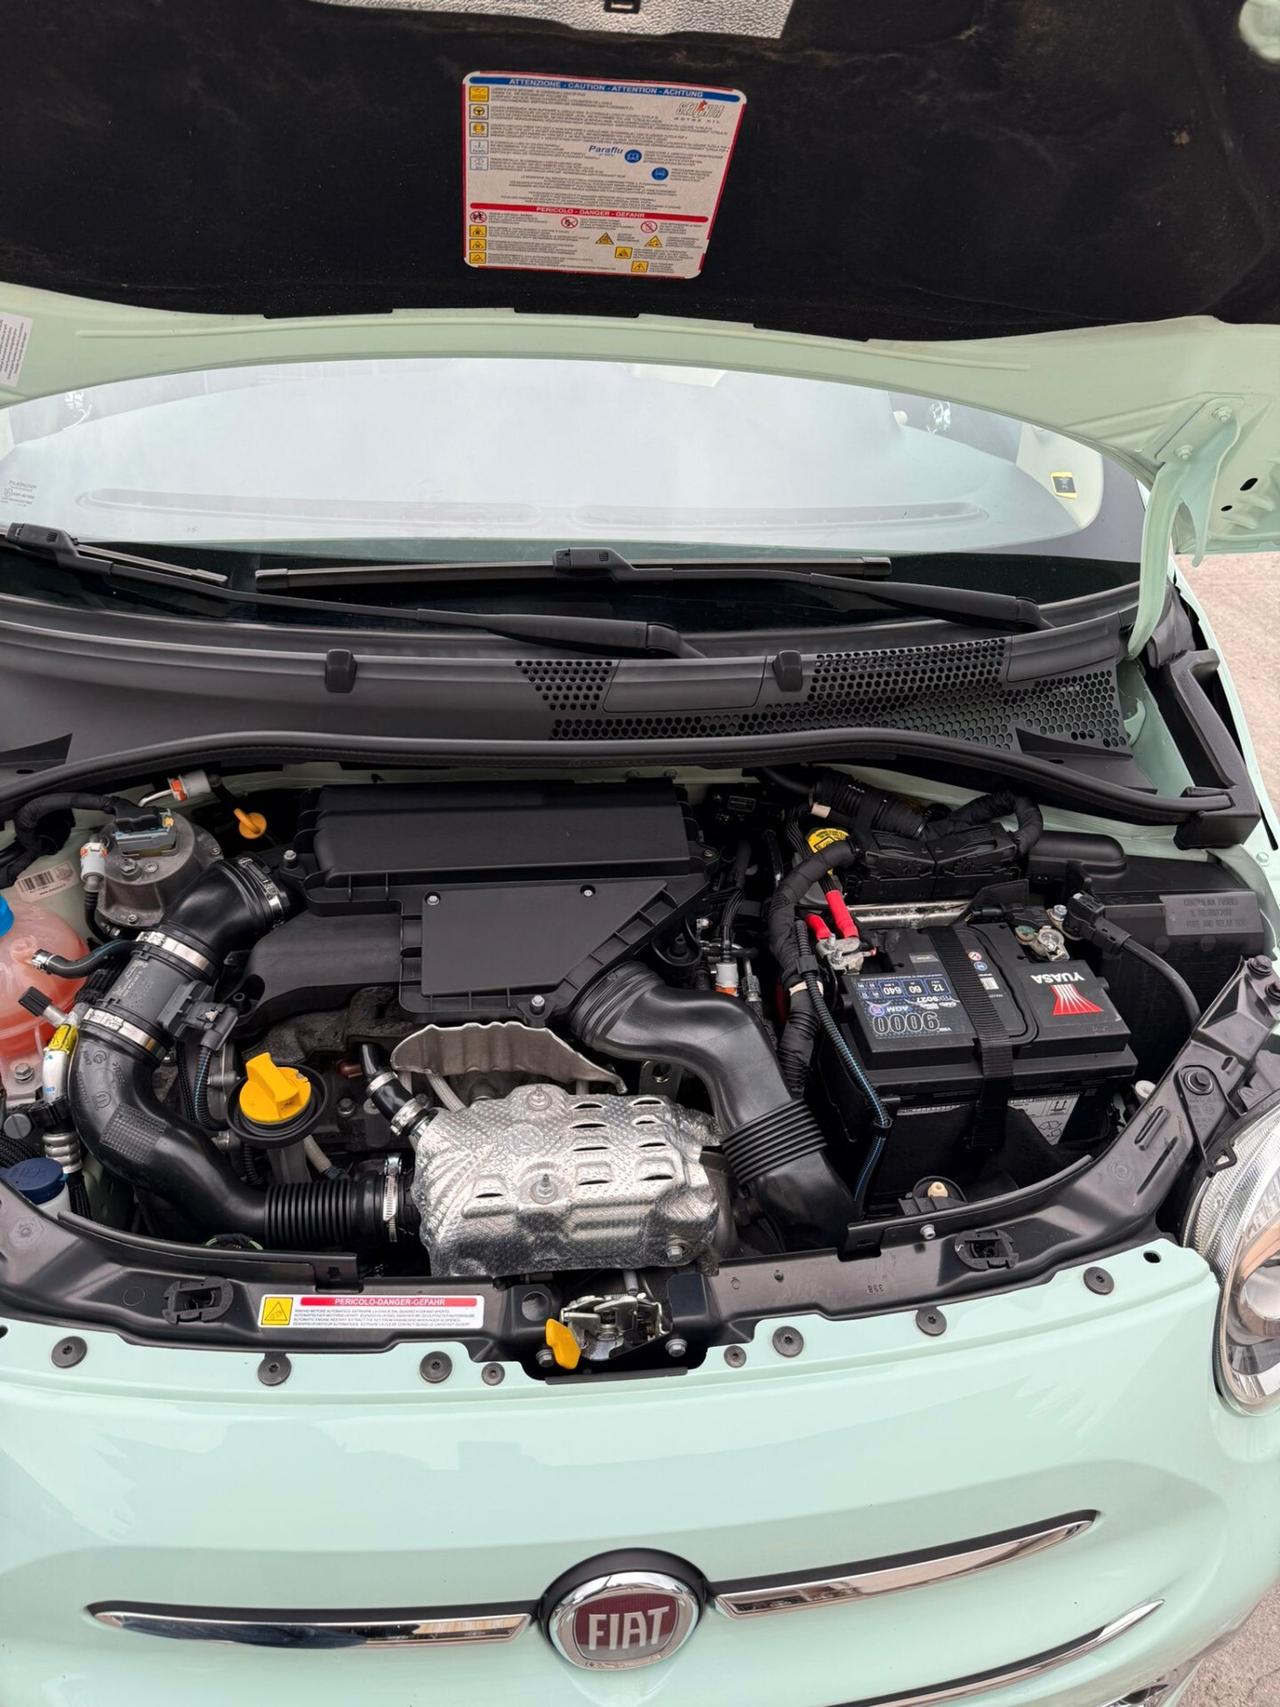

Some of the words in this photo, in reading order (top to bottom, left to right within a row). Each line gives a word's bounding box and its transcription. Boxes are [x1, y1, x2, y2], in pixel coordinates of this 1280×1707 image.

[509, 79, 561, 89] ATTENZIONE
[568, 82, 606, 92] CAUTION
[611, 85, 658, 95] ATTENTION
[663, 88, 703, 98] ACHTUNG
[589, 145, 624, 155] Paraflu
[536, 207, 573, 215] PERICOLO
[580, 209, 609, 217] DANGER
[1030, 972, 1085, 984] YUASA
[932, 984, 945, 992] 12
[872, 1011, 940, 1035] 9000
[588, 1606, 670, 1650] FIAT
